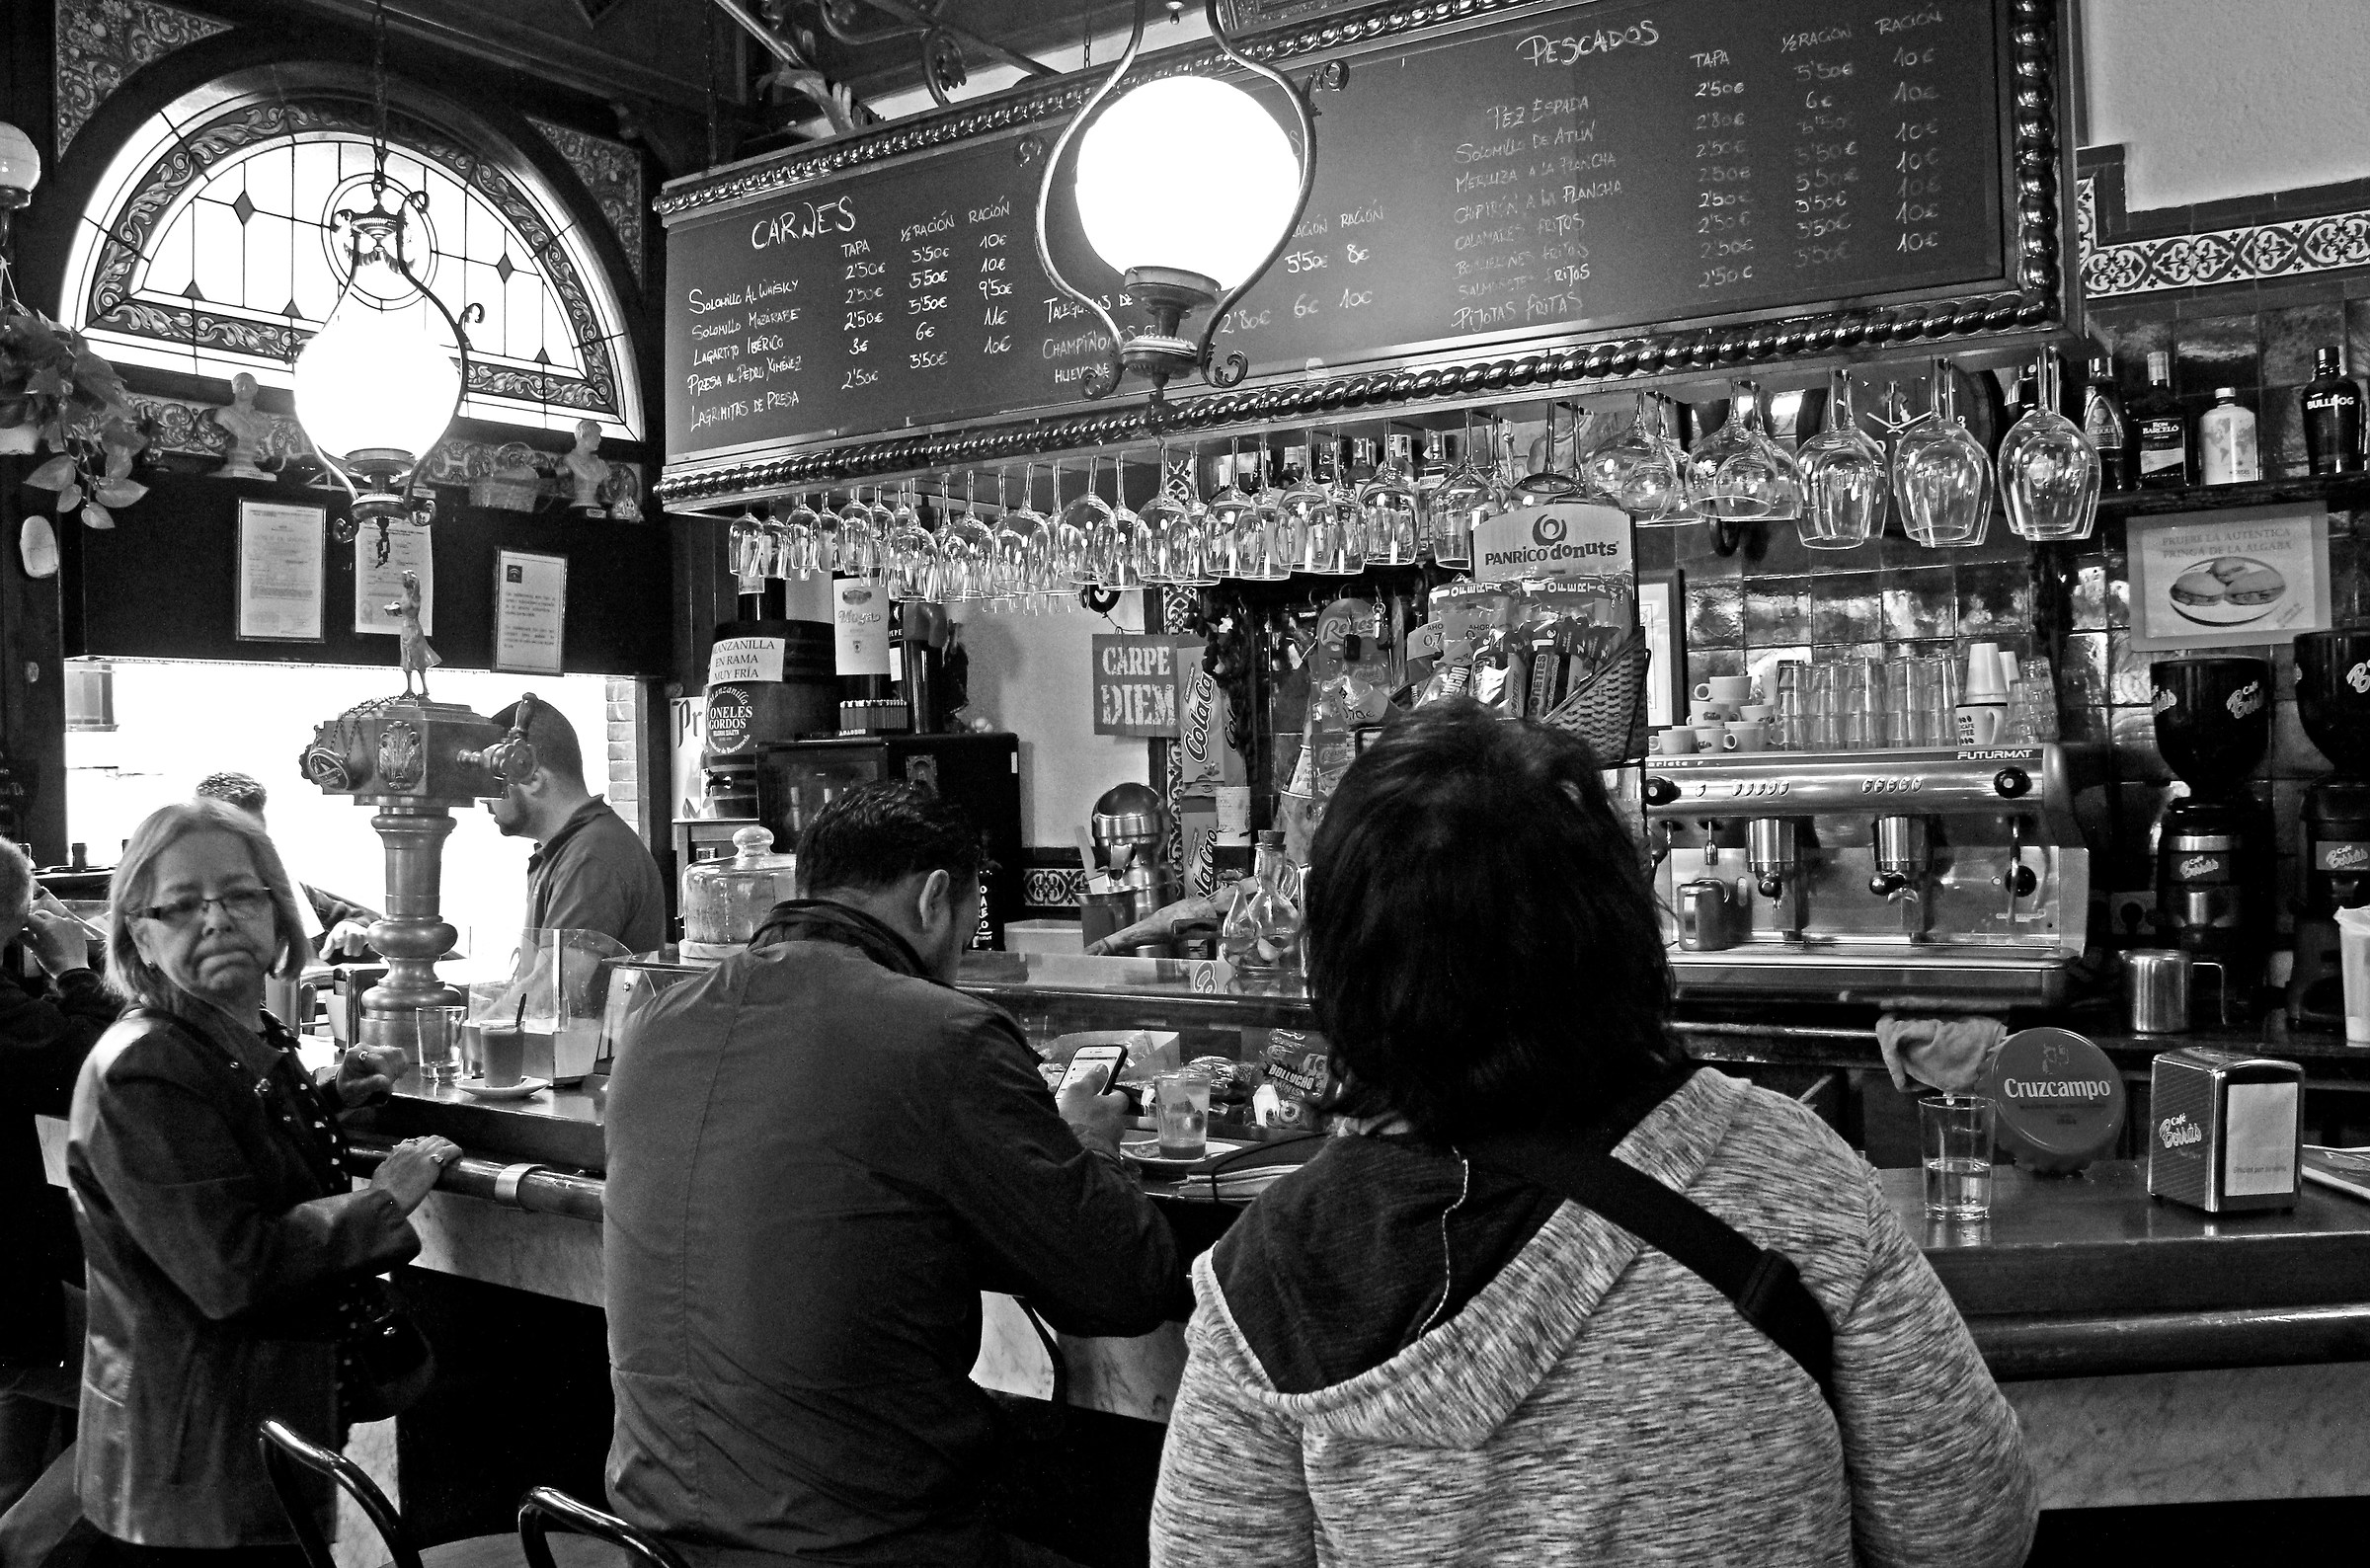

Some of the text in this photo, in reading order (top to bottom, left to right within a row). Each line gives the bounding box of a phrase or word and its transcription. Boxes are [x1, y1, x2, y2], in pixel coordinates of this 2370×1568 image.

[1516, 20, 1659, 66] PESCADOS
[1690, 50, 1730, 67] TAPA
[1695, 82, 1745, 97] 2'50€
[1486, 96, 1589, 129] PEZ ESPADA
[1533, 133, 1549, 148] DE
[1529, 166, 1537, 176] A
[1562, 180, 1622, 203] PLANCHA
[969, 196, 1009, 223] RACIÓN
[1340, 199, 1382, 228] RACIÓN
[751, 196, 856, 250] CARNES
[1293, 214, 1327, 238] ACIÓN
[841, 239, 871, 257] TAPA
[689, 278, 799, 314] SOLOMILLO AL WHISKY
[1119, 293, 1133, 307] DE
[985, 306, 1008, 325] 11€
[1451, 291, 1583, 333] PIJOTAS FRITAS
[691, 319, 742, 340] SOLOMILLO
[915, 322, 934, 341] 6€
[748, 335, 784, 354] IBÉRICO
[849, 338, 869, 354] 3€
[687, 373, 722, 396] PRESA
[727, 373, 738, 384] AL
[737, 363, 764, 383] PEDRO
[753, 398, 764, 413] DE
[767, 391, 800, 410] PRESA
[1549, 541, 1618, 561] donuts
[715, 655, 759, 667] EN RAMA
[1102, 645, 1171, 676] CARPE
[714, 667, 759, 681] MUY FRÍA
[1099, 683, 1177, 727] DIEM
[709, 717, 747, 730] GORDOS
[1957, 749, 2033, 760] FUTURMAT
[2004, 1078, 2111, 1100] Cruzcampo
[2171, 1113, 2186, 1126] Café
